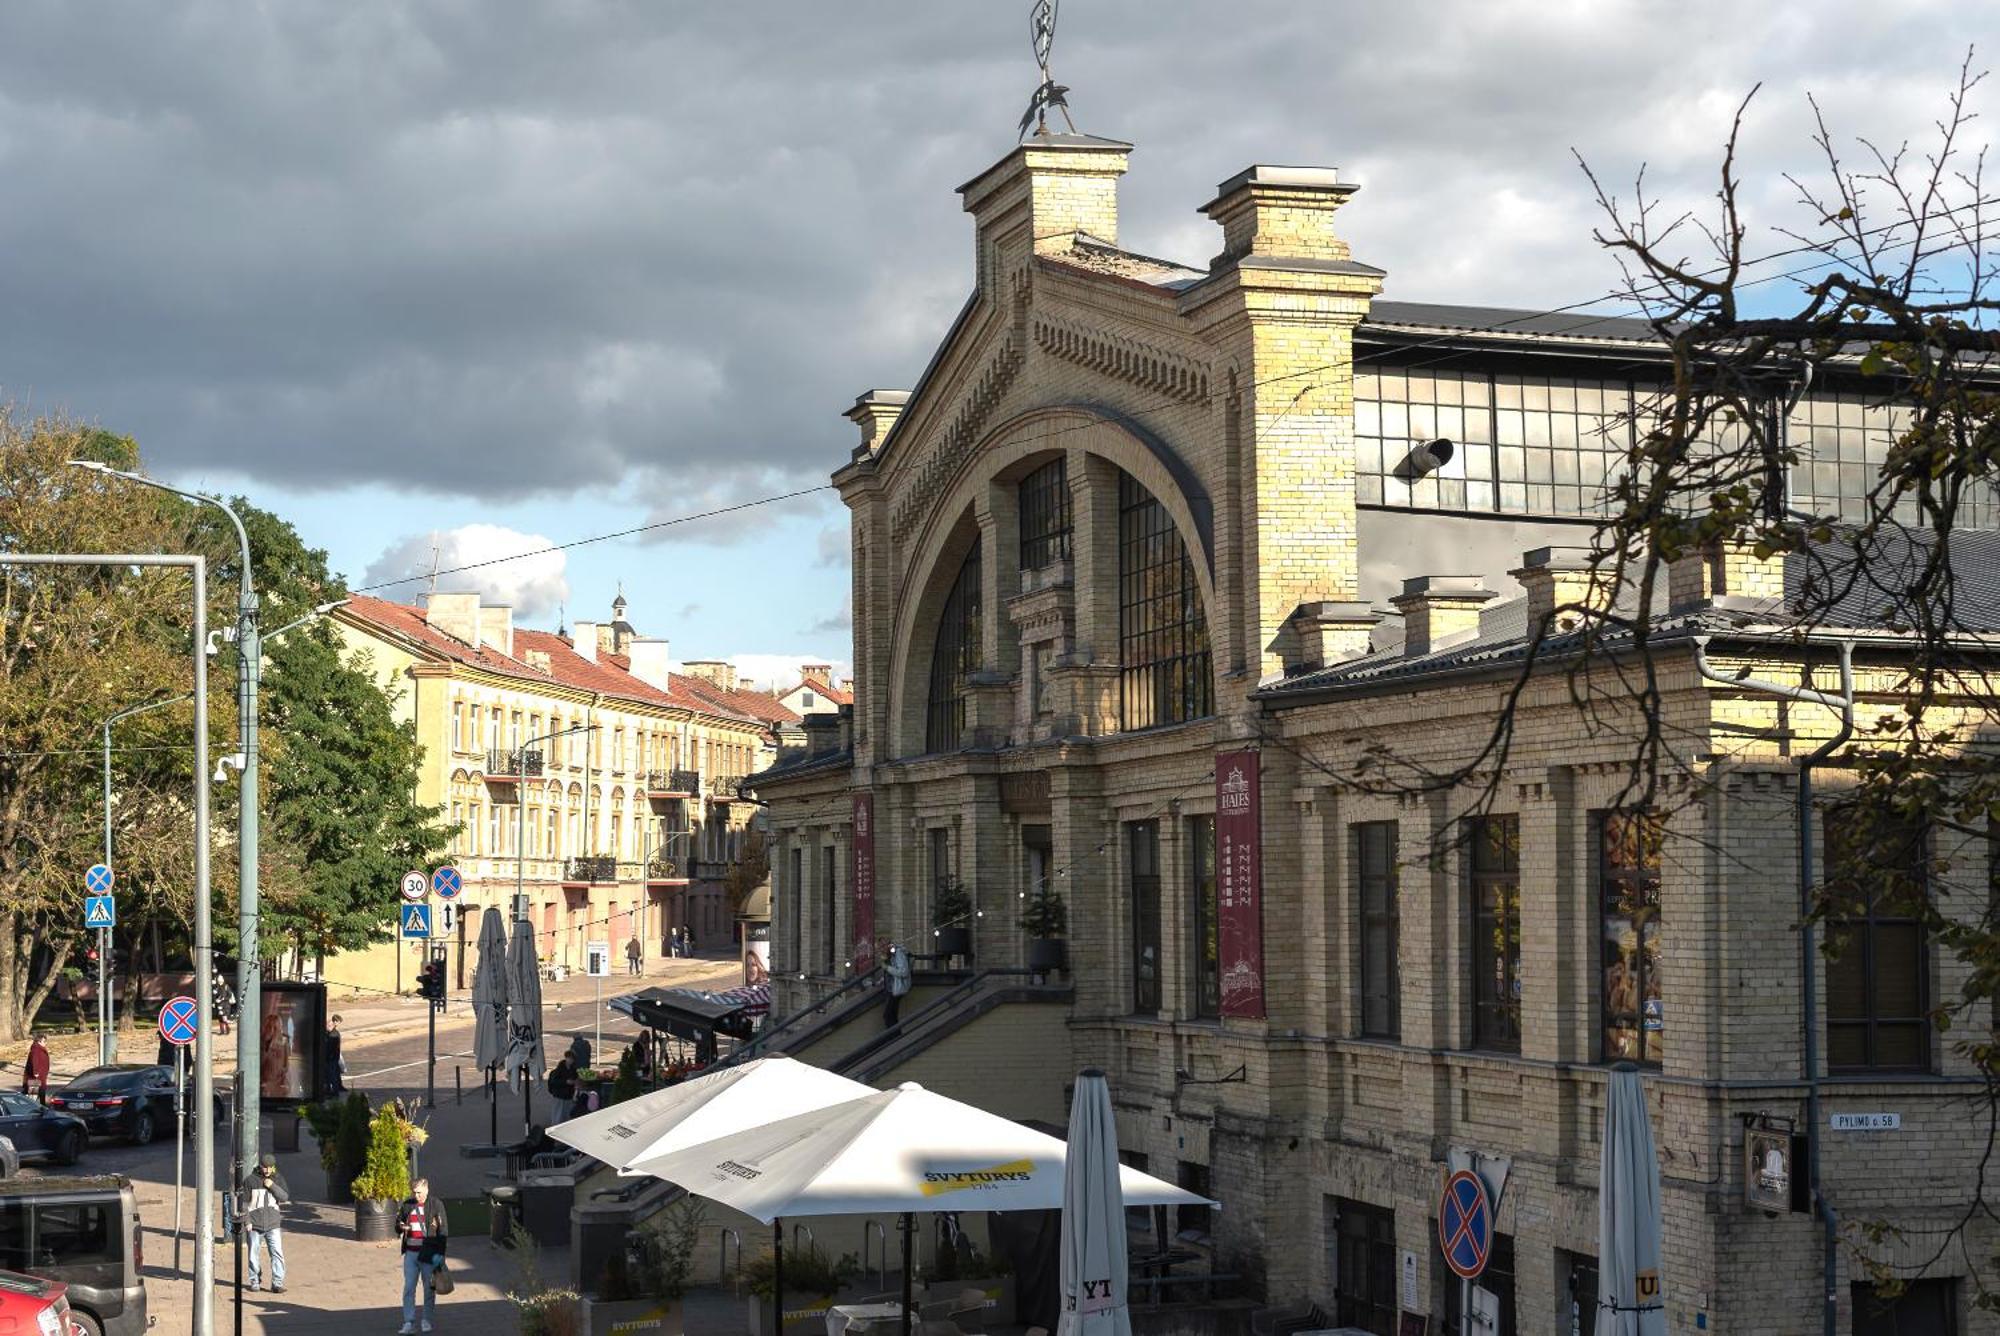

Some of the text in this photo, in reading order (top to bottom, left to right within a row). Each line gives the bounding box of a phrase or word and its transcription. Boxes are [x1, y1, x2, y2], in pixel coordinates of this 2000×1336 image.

[408, 879, 423, 892] 30
[1839, 1116, 1870, 1128] PYLIMO
[1882, 1115, 1893, 1127] 58
